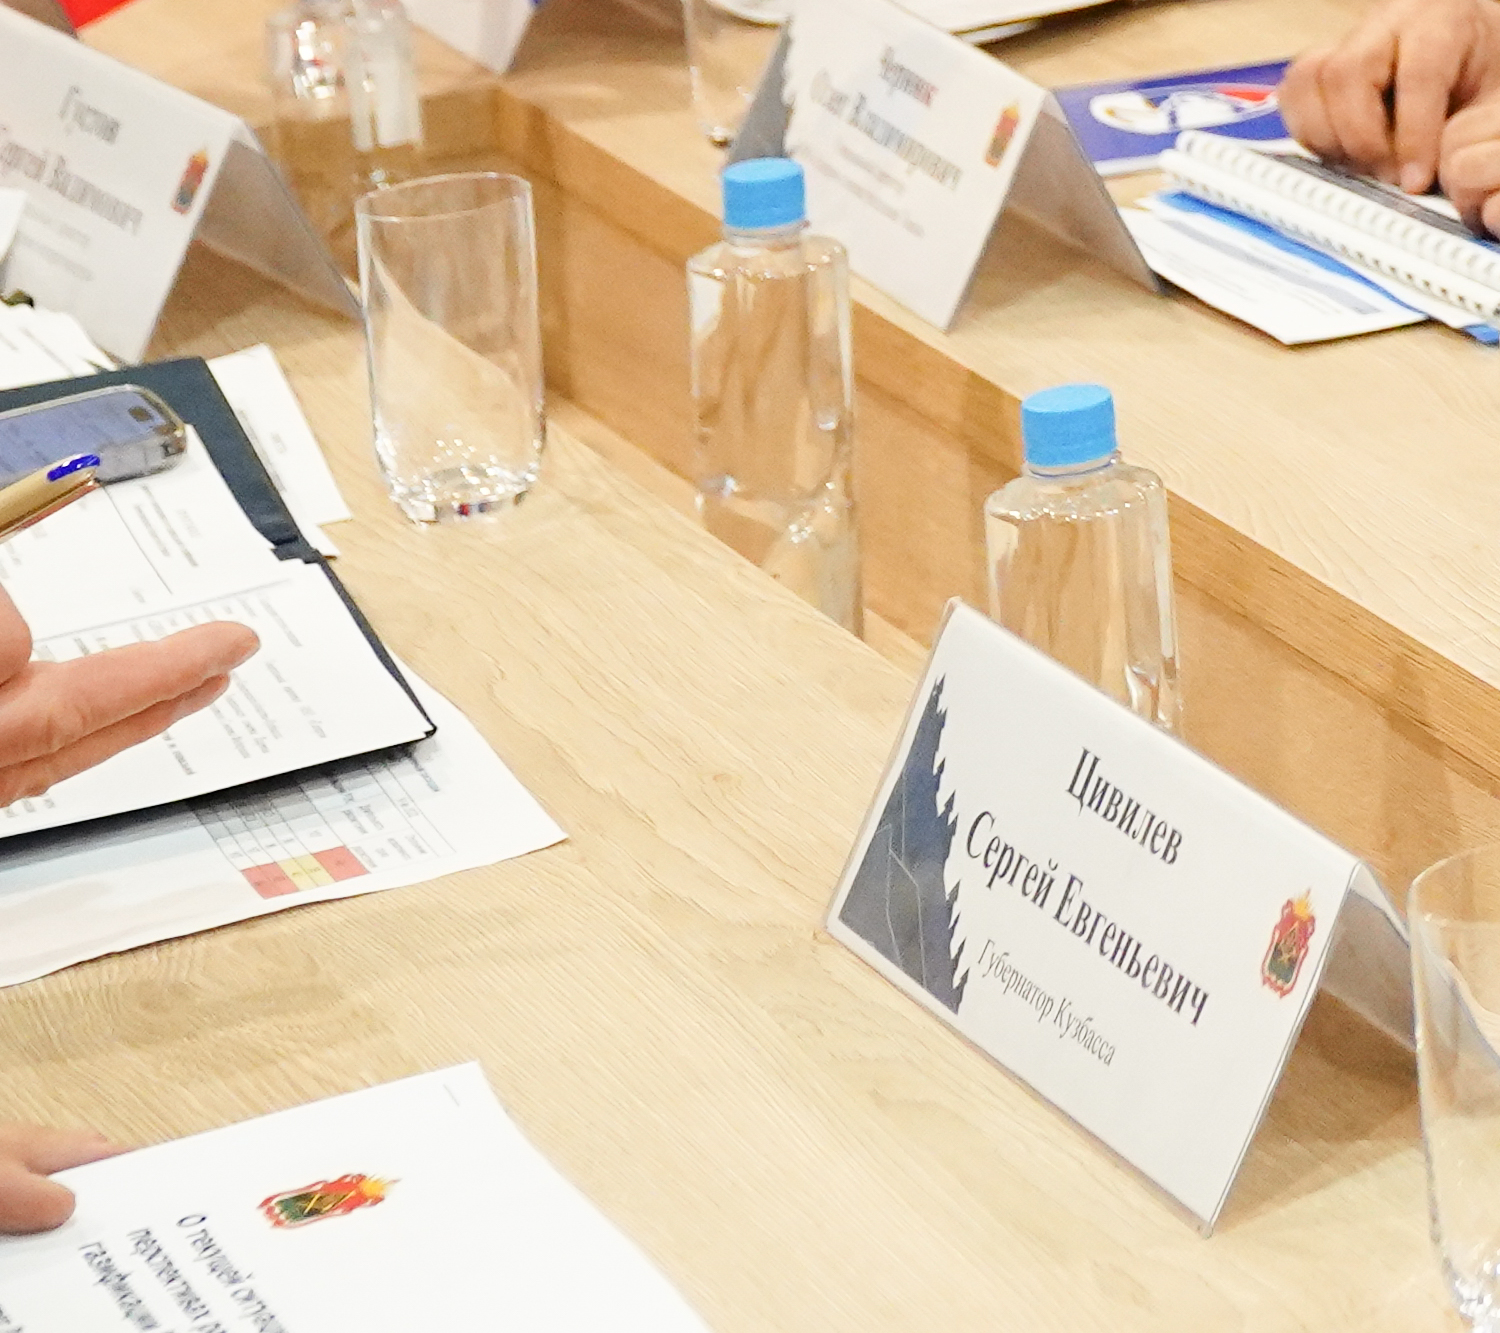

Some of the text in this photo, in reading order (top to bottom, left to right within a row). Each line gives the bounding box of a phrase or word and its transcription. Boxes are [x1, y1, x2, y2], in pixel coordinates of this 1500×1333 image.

[1066, 746, 1184, 866] Цивилев
[966, 810, 1211, 1027] Сергей Евгеньевич
[977, 938, 1116, 1067] Губернатор Кузбасса
